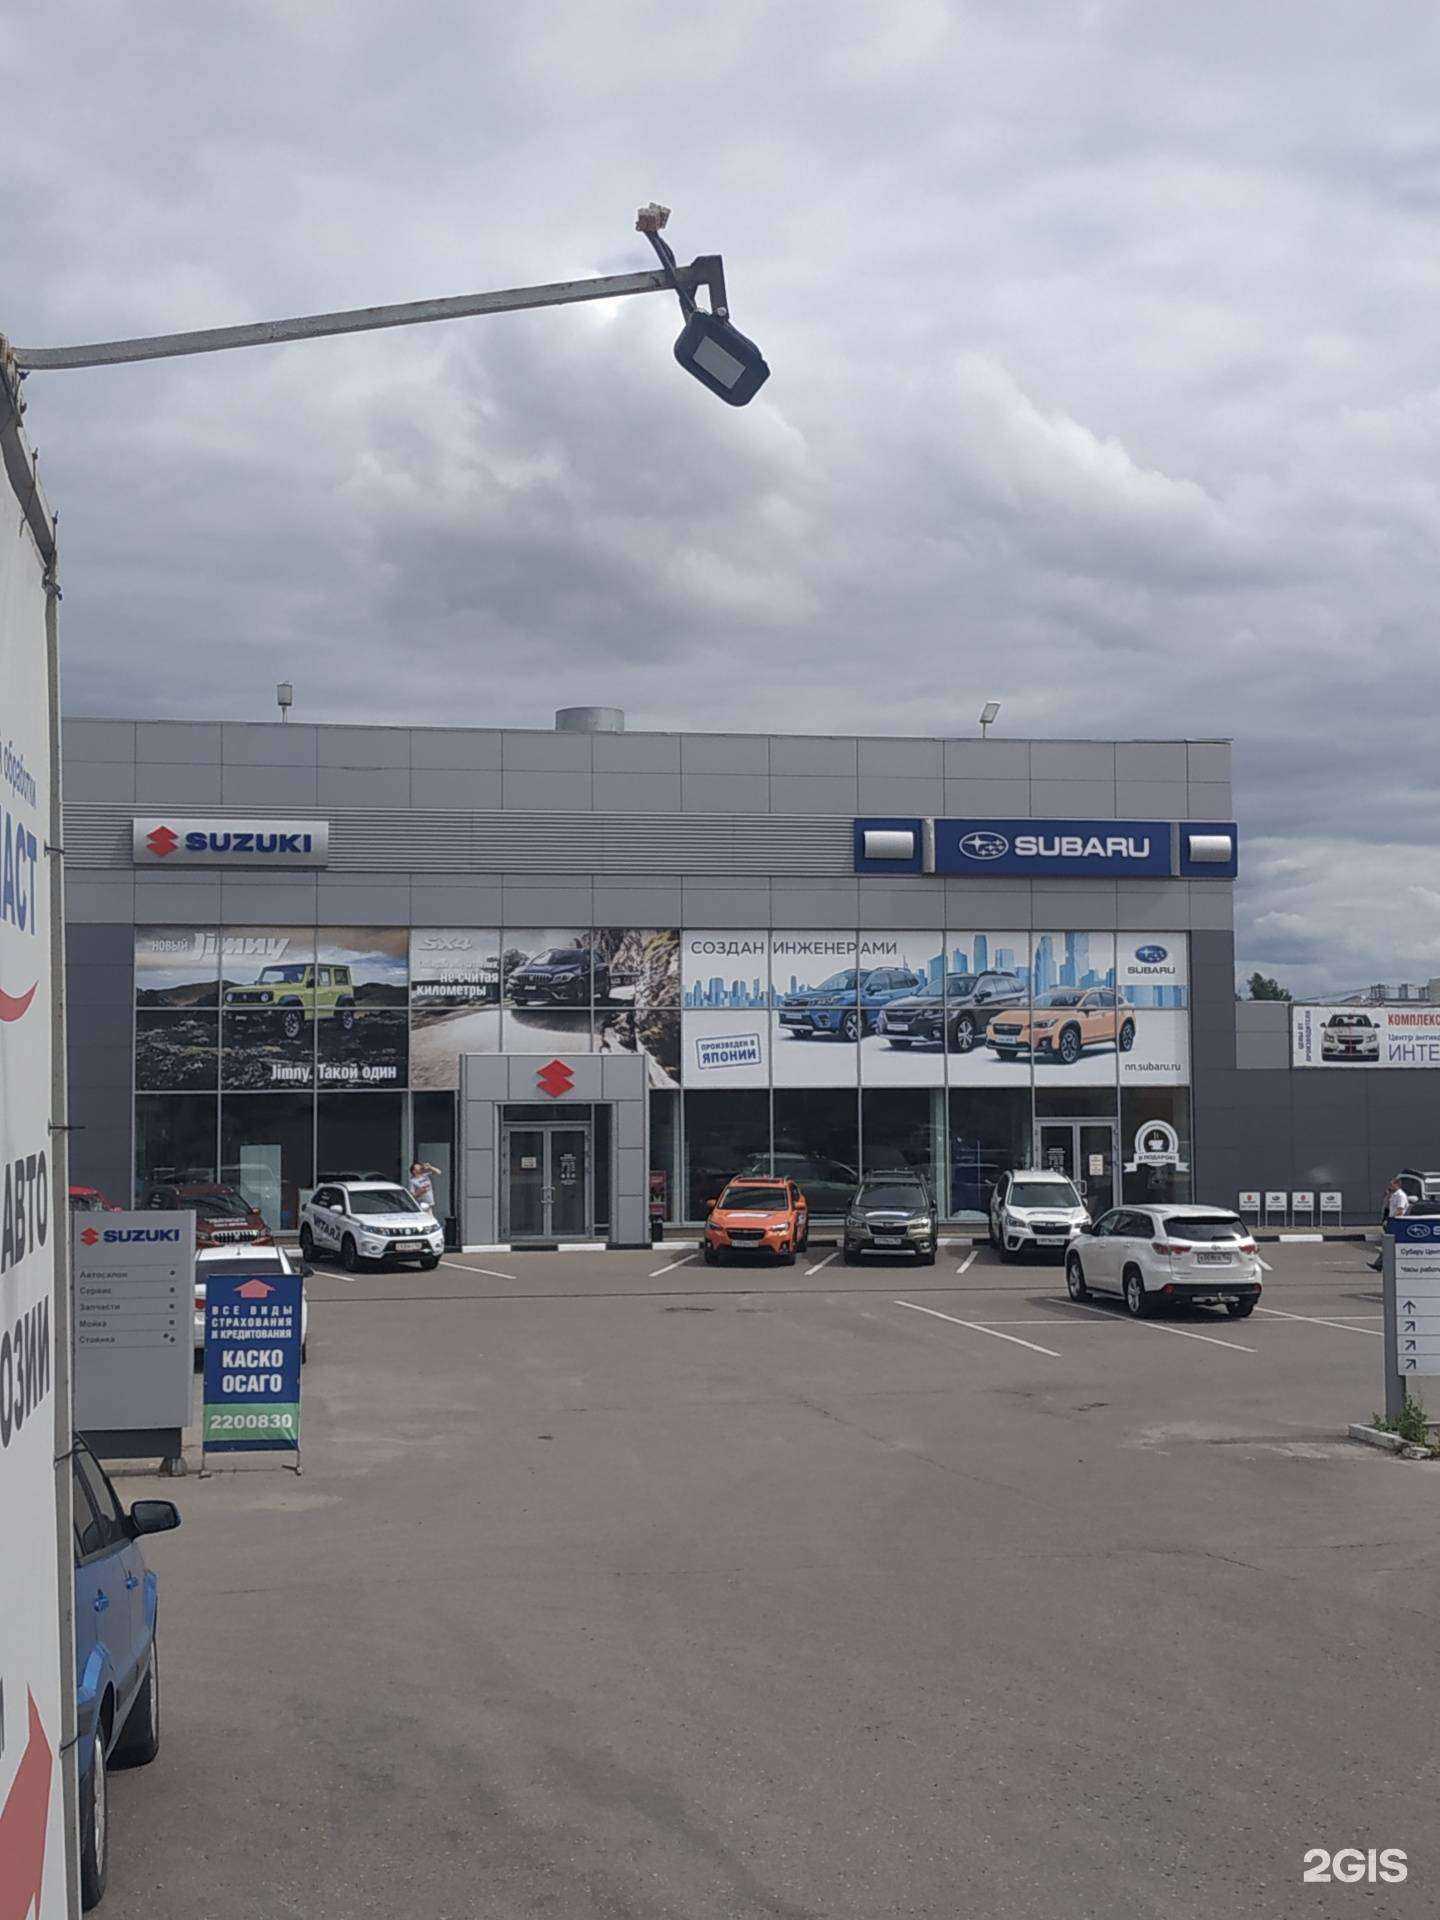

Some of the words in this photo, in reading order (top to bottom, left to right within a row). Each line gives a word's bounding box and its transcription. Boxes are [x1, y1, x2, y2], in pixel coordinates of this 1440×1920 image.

[185, 832, 312, 853] SUZUKI
[1014, 836, 1150, 858] SUBARU
[691, 941, 764, 956] СОЗДАН
[773, 941, 897, 955] ИНЖЕНЕРАМИ
[1127, 966, 1176, 975] SUBARU
[416, 984, 487, 998] километры
[701, 1041, 748, 1051] ПРОИЗВЕДЕН
[702, 1048, 756, 1064] ЯПОНИИ
[271, 1064, 313, 1083] Jimny.
[318, 1063, 358, 1080] Такой
[361, 1066, 397, 1081] один
[1124, 1062, 1181, 1072] nn.subaru.ru
[0, 1150, 48, 1275] АВТО
[103, 1229, 180, 1243] SUZUKI
[80, 1271, 128, 1279] Автосалон
[212, 1306, 240, 1315] ВСЕ
[250, 1306, 292, 1317] ВИДЫ
[212, 1317, 292, 1327] СТРАХОВАНИЯ
[220, 1329, 292, 1340] КРЕДИТОВАНИЯ
[222, 1349, 283, 1368] КАСКО
[222, 1374, 282, 1393] ОСАГО
[210, 1415, 292, 1429] 2200830
